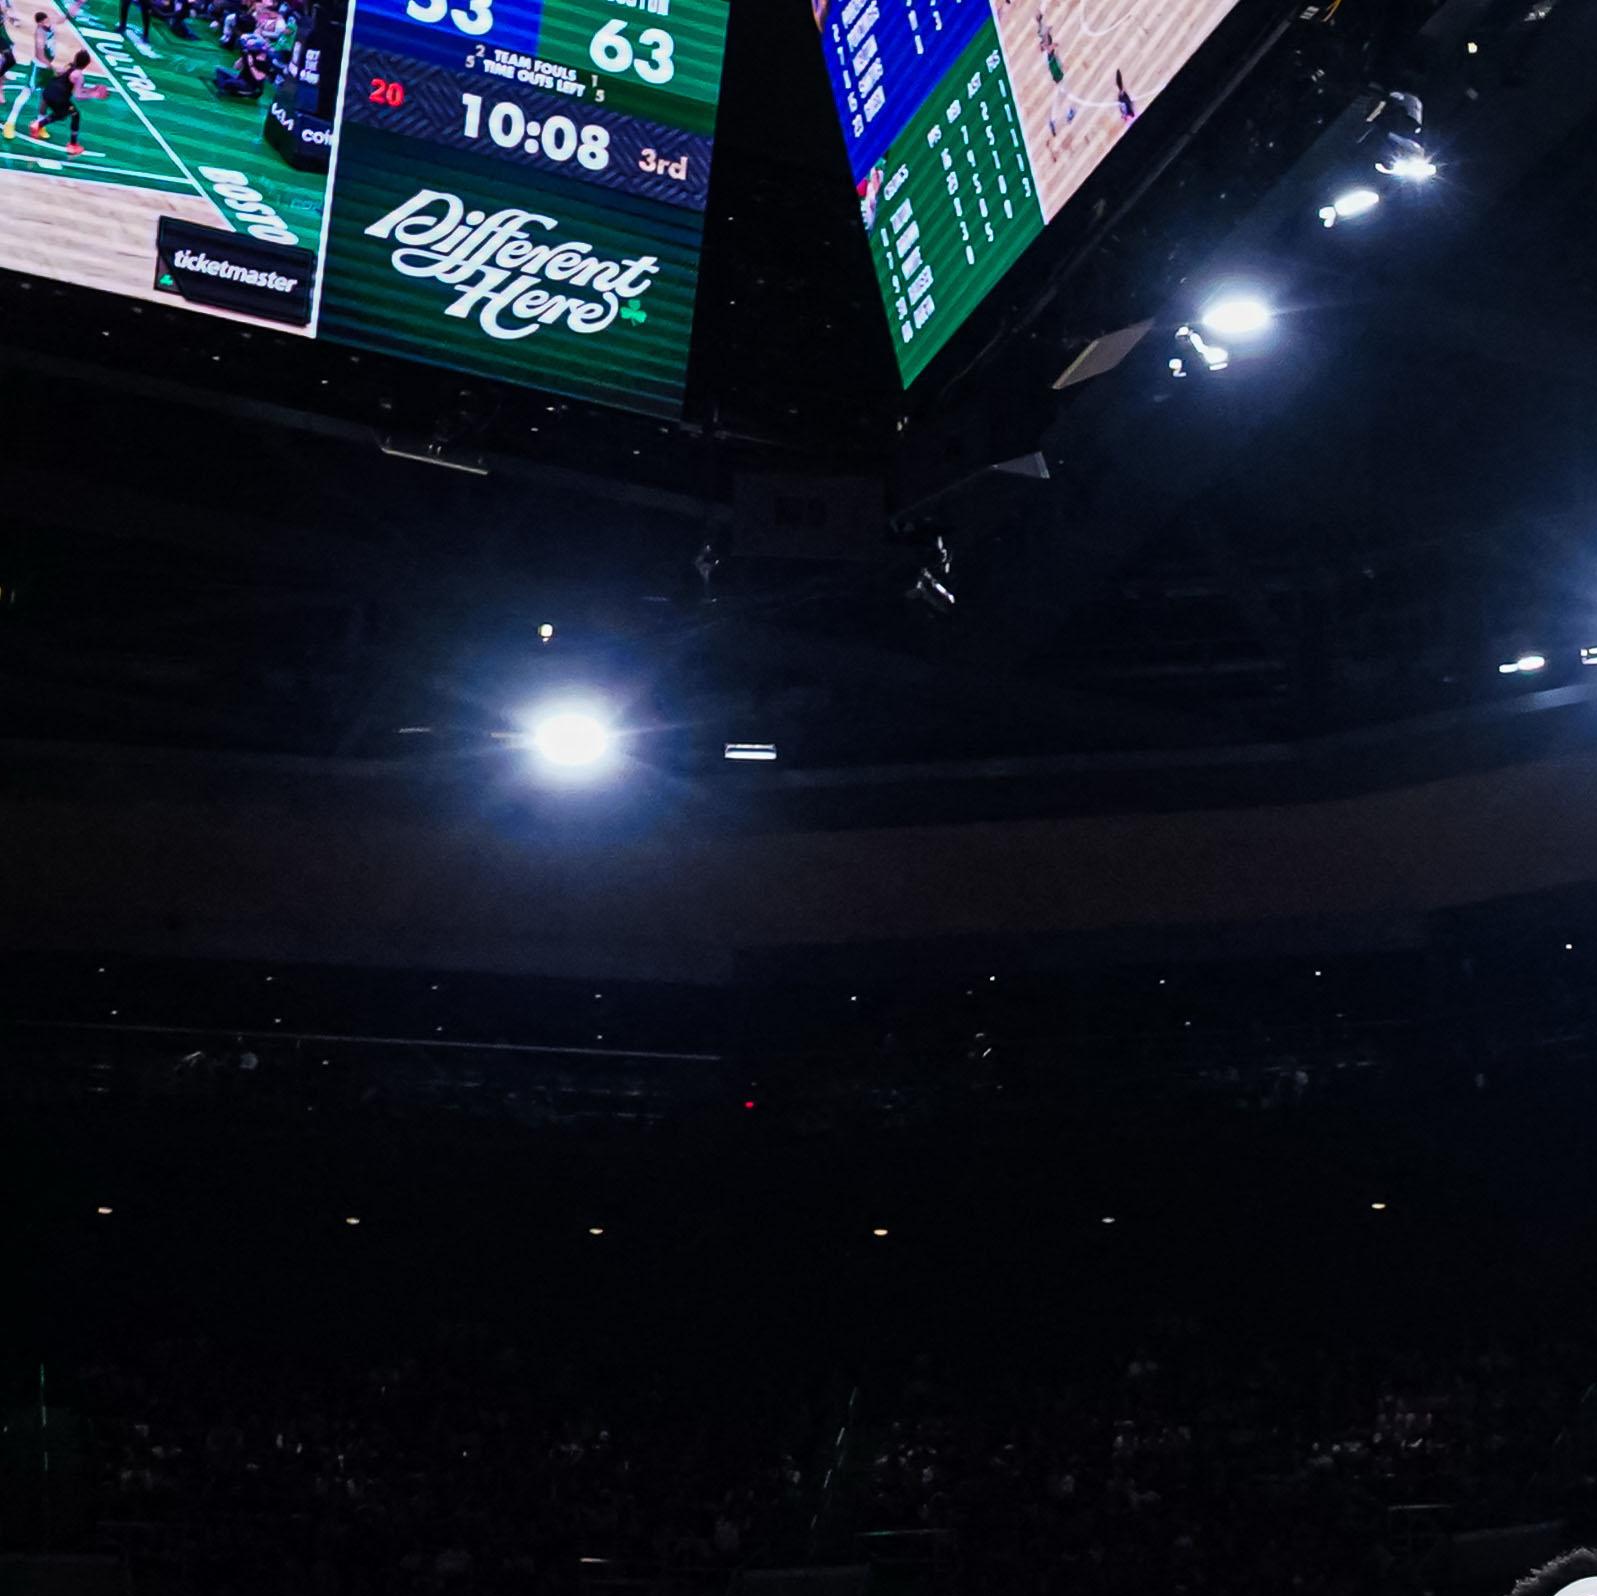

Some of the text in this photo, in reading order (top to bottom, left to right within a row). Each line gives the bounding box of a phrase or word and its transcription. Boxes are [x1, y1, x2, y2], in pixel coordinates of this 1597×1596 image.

[494, 49, 531, 69] TEAM
[534, 57, 577, 82] FOULS
[591, 19, 675, 85] 63
[369, 78, 404, 107] 20
[483, 59, 516, 80] TIME
[518, 69, 554, 90] OUTS
[556, 79, 587, 98] LEFT
[462, 92, 611, 171] 10:08
[638, 148, 688, 181] 3rd
[364, 189, 660, 298] Different
[173, 250, 298, 293] ticketmaster
[444, 265, 620, 340] Here
